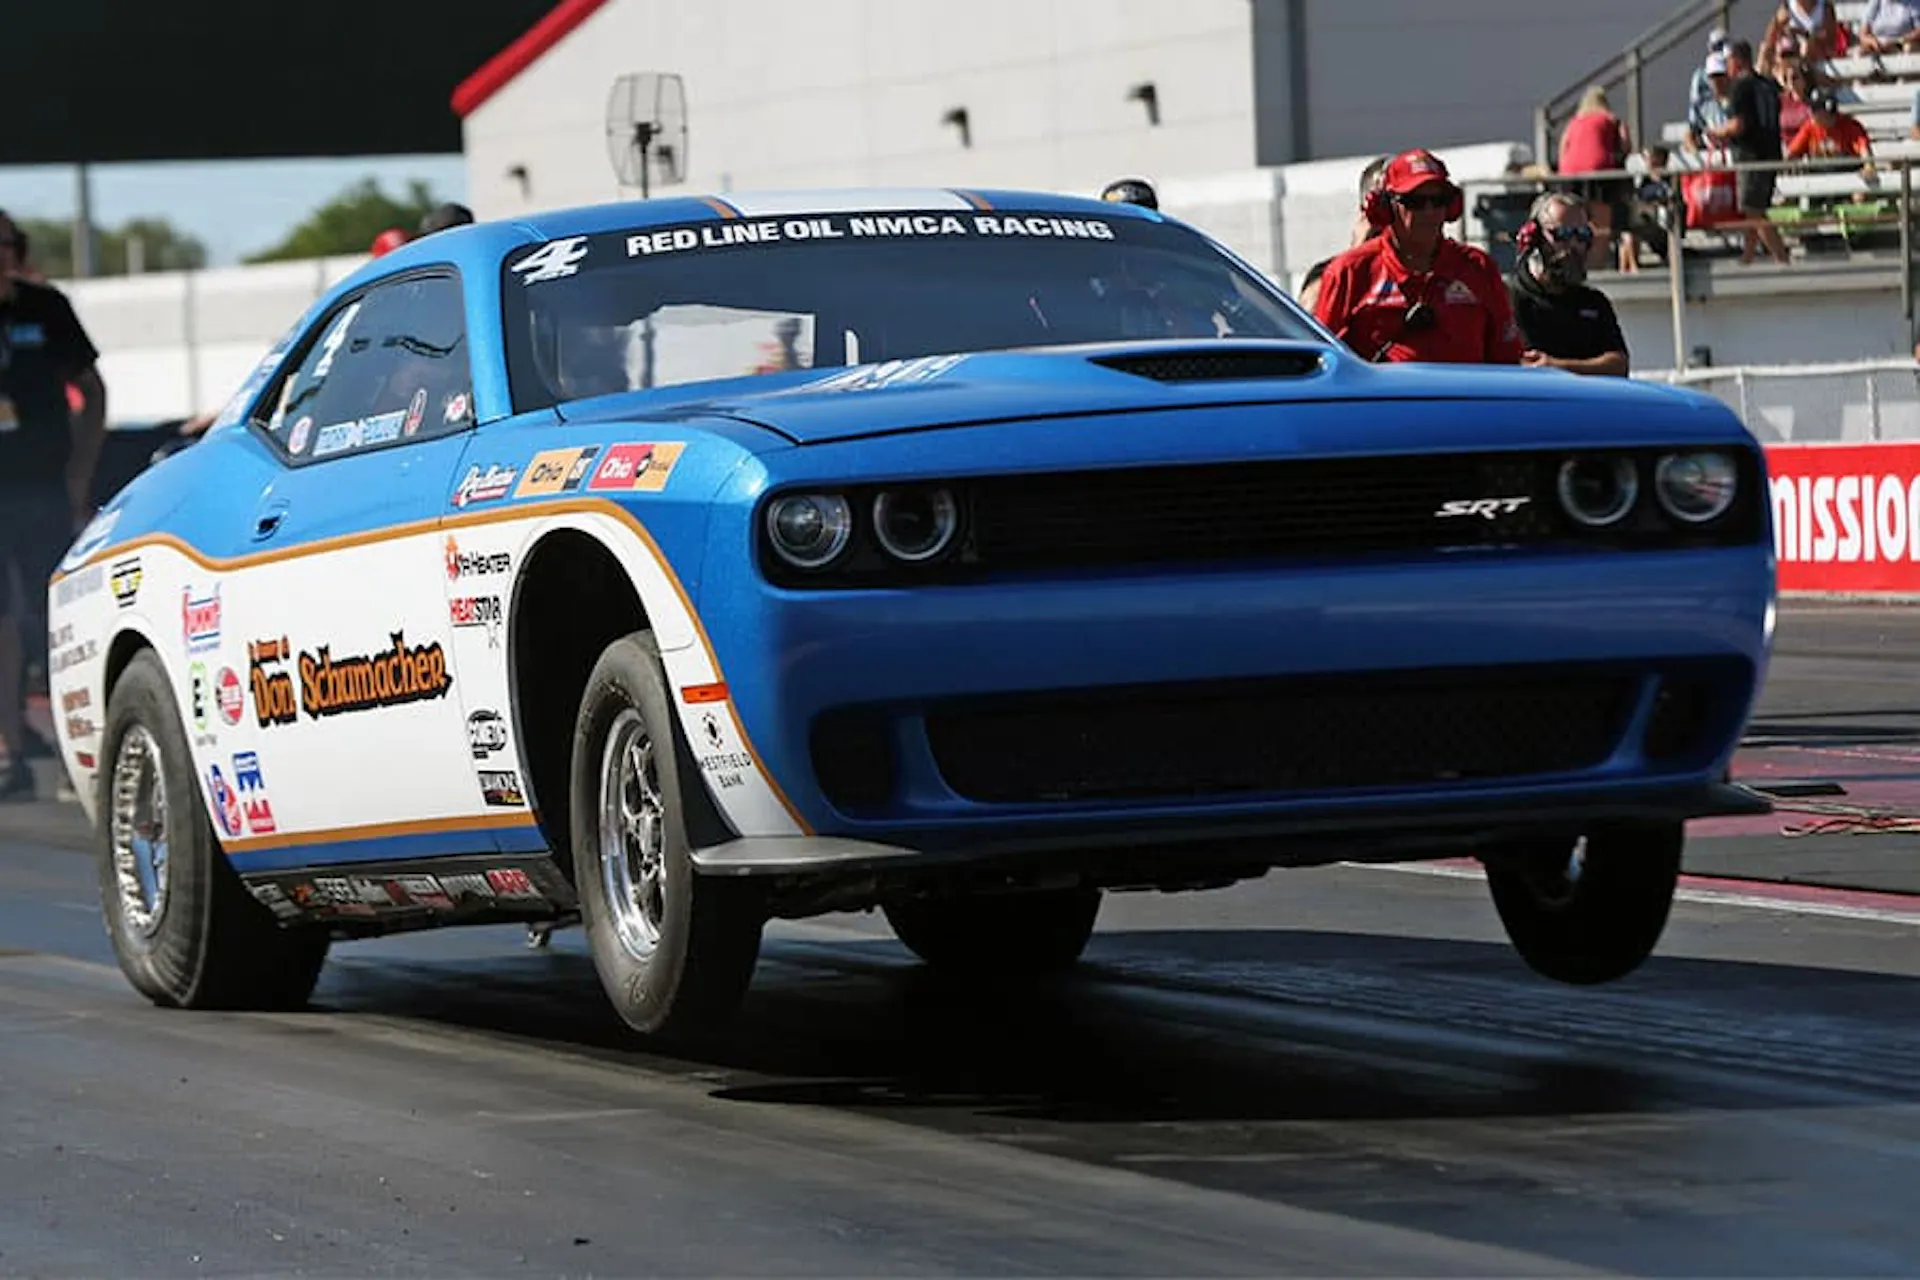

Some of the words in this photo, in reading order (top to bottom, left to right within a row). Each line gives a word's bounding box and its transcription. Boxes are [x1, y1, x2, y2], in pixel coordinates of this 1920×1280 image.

[626, 231, 697, 257] RED
[701, 222, 781, 248] LINE
[783, 219, 844, 240] OIL
[850, 216, 968, 237] NMCA
[971, 216, 1116, 241] RACING
[531, 462, 564, 483] Ohio
[600, 457, 632, 479] Ohio
[1434, 496, 1531, 519] SRT
[249, 660, 297, 728] Don
[299, 631, 453, 720] Schumacher
